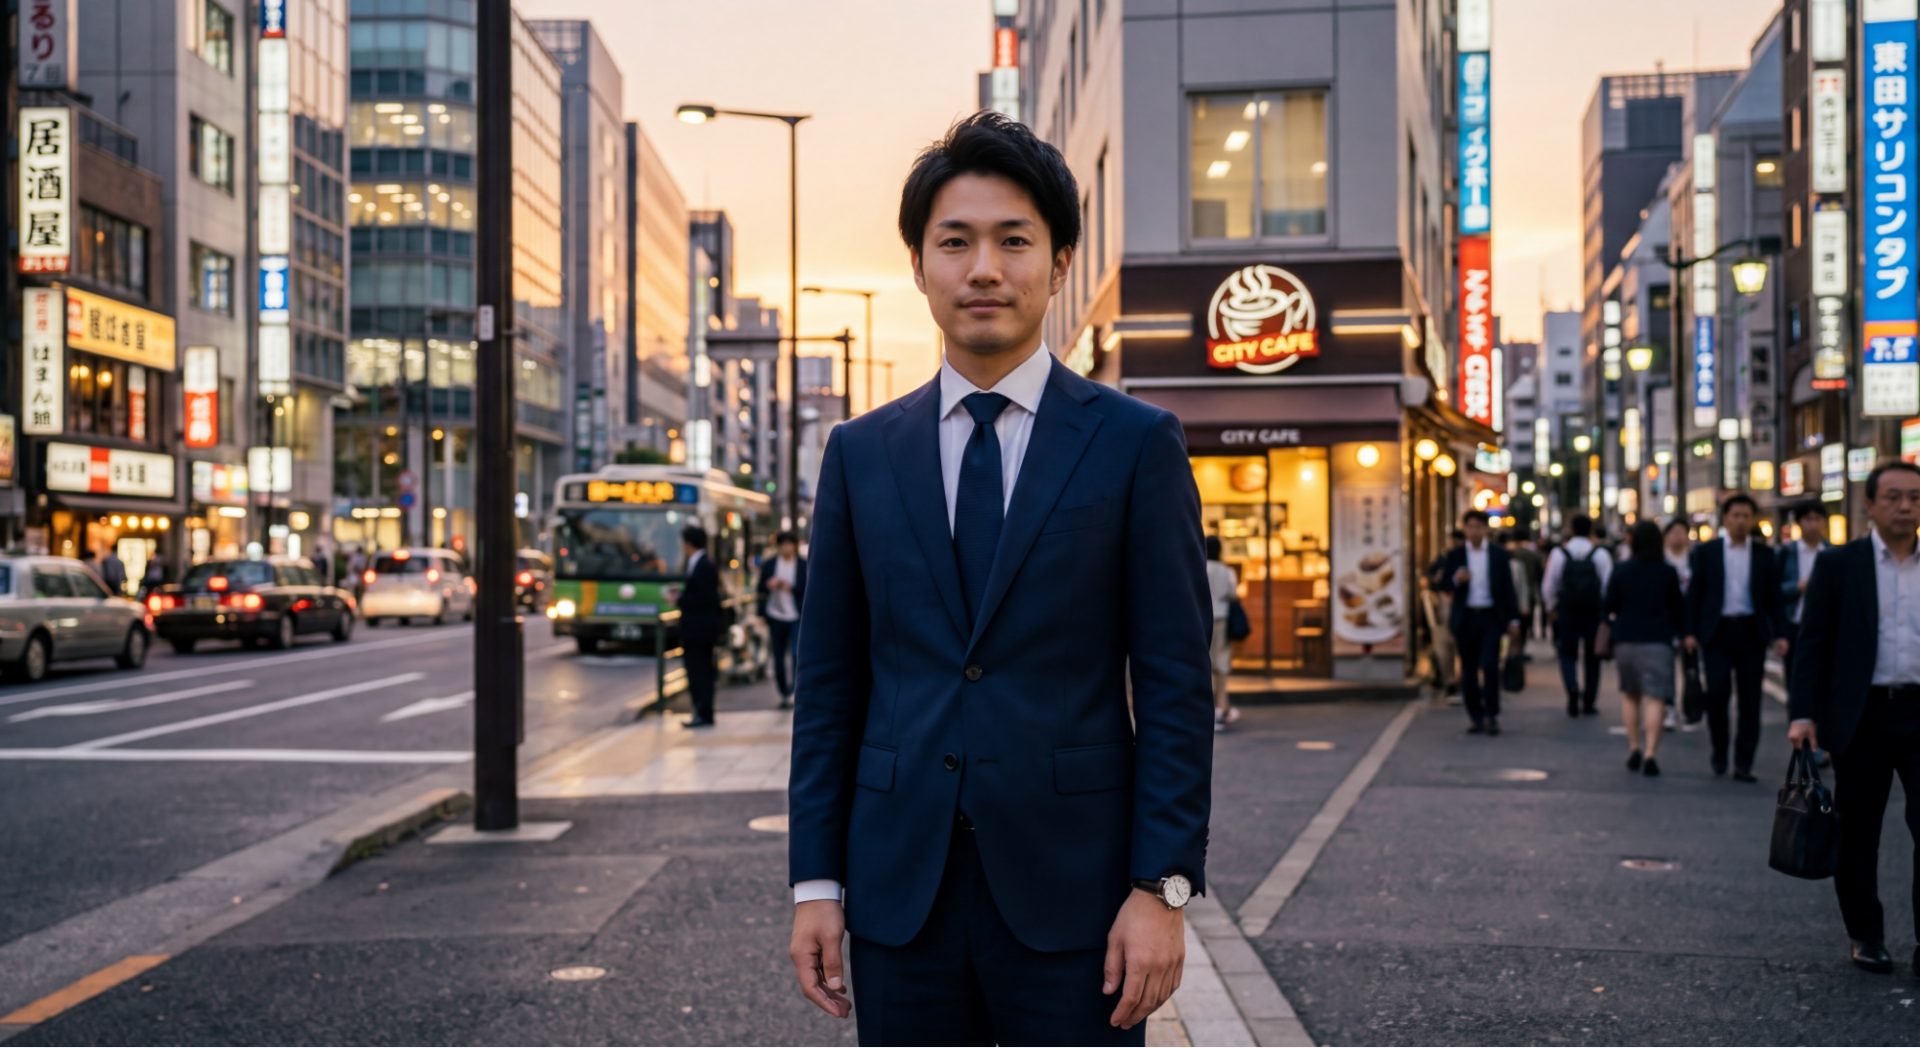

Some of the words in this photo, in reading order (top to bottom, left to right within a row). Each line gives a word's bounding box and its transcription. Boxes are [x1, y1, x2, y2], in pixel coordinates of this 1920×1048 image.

[30, 0, 55, 60] るり
[27, 119, 61, 247] 居酒屋
[1213, 340, 1259, 363] CITY
[1260, 332, 1314, 356] CAFE
[1220, 429, 1257, 444] CITY
[1259, 428, 1300, 444] CAFE
